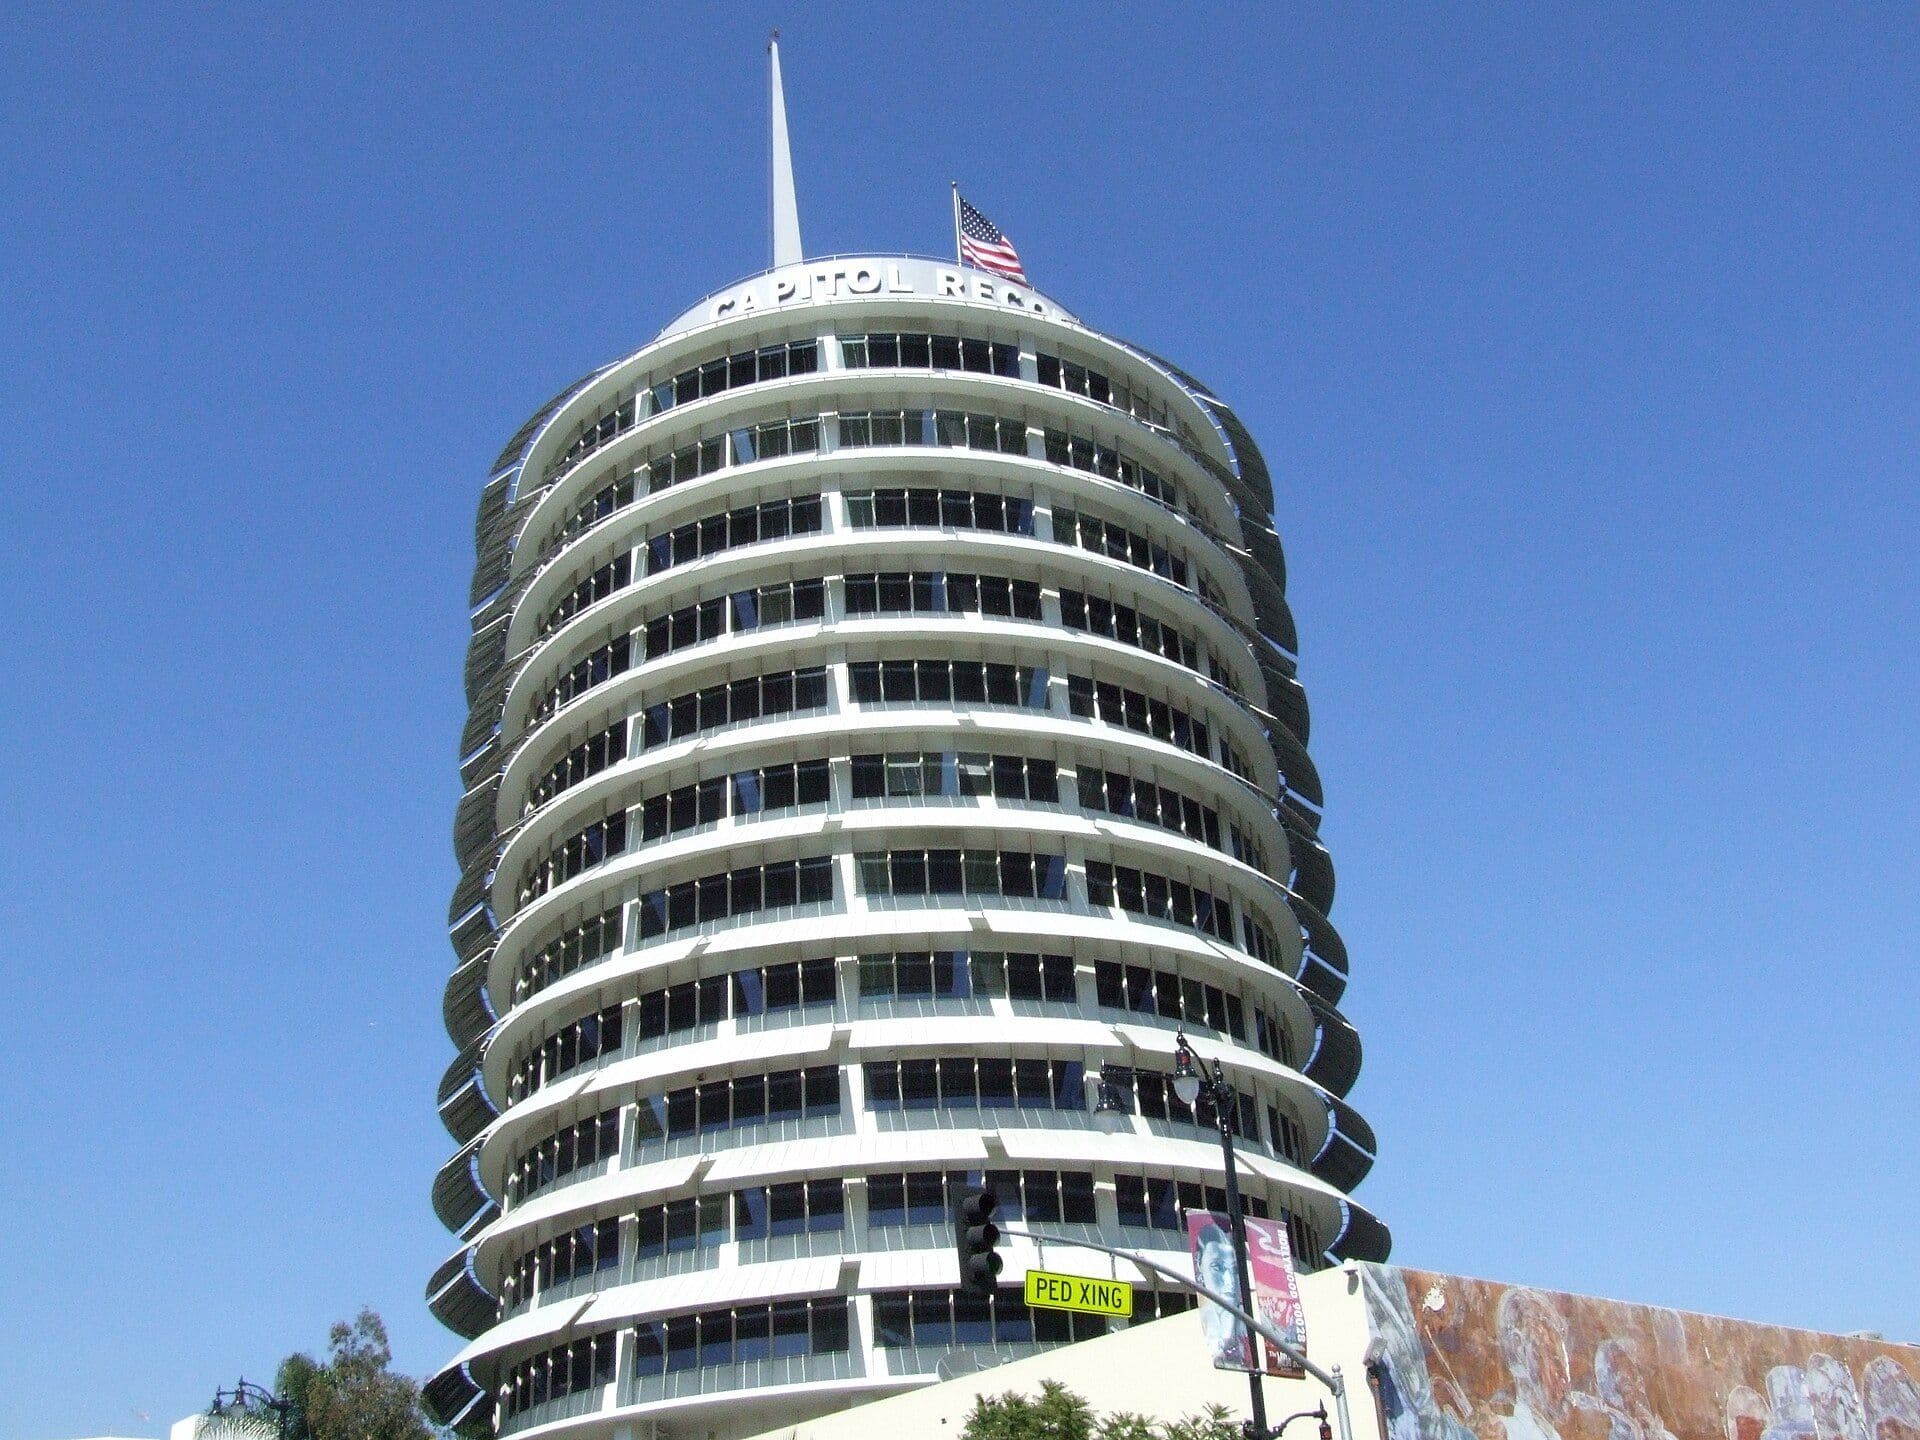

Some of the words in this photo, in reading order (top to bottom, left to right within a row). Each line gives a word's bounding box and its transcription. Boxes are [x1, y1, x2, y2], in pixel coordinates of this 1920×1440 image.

[710, 264, 914, 319] CAPITOL
[936, 268, 1056, 316] RECO
[1036, 1278, 1072, 1302] PED
[1079, 1282, 1122, 1309] XING
[1277, 1229, 1298, 1300] HOLLYWOOD
[1292, 1302, 1306, 1343] 90028
